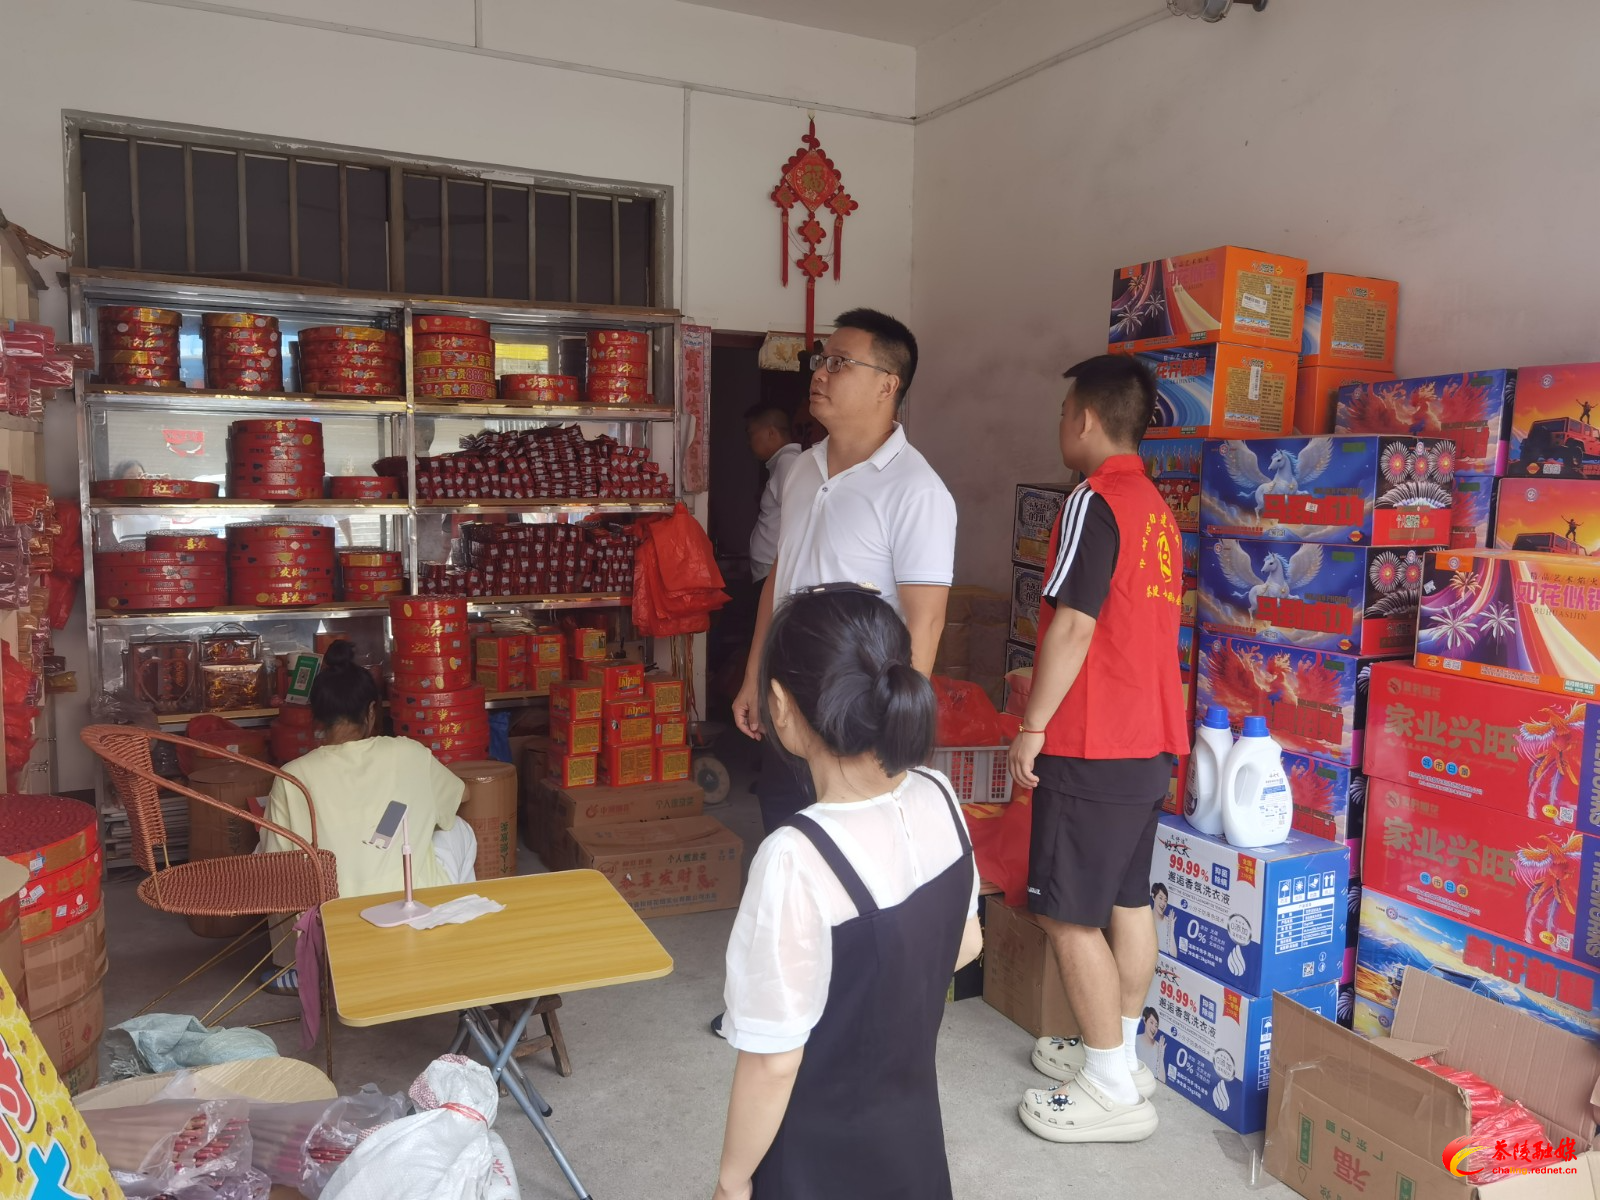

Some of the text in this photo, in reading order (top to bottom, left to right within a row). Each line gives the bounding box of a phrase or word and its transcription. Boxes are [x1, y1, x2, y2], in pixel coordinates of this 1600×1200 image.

[801, 164, 824, 193] 福
[1384, 703, 1520, 763] 家业兴旺
[1169, 854, 1209, 882] 99.99%
[1383, 816, 1517, 886] 家业兴旺
[620, 867, 691, 890] 恭喜发财
[1168, 870, 1230, 905] 邂逅香氛洗衣液
[1160, 981, 1197, 1013] 99.99%
[1159, 997, 1217, 1039] 邂逅香氛洗衣液
[1334, 1146, 1370, 1192] 福
